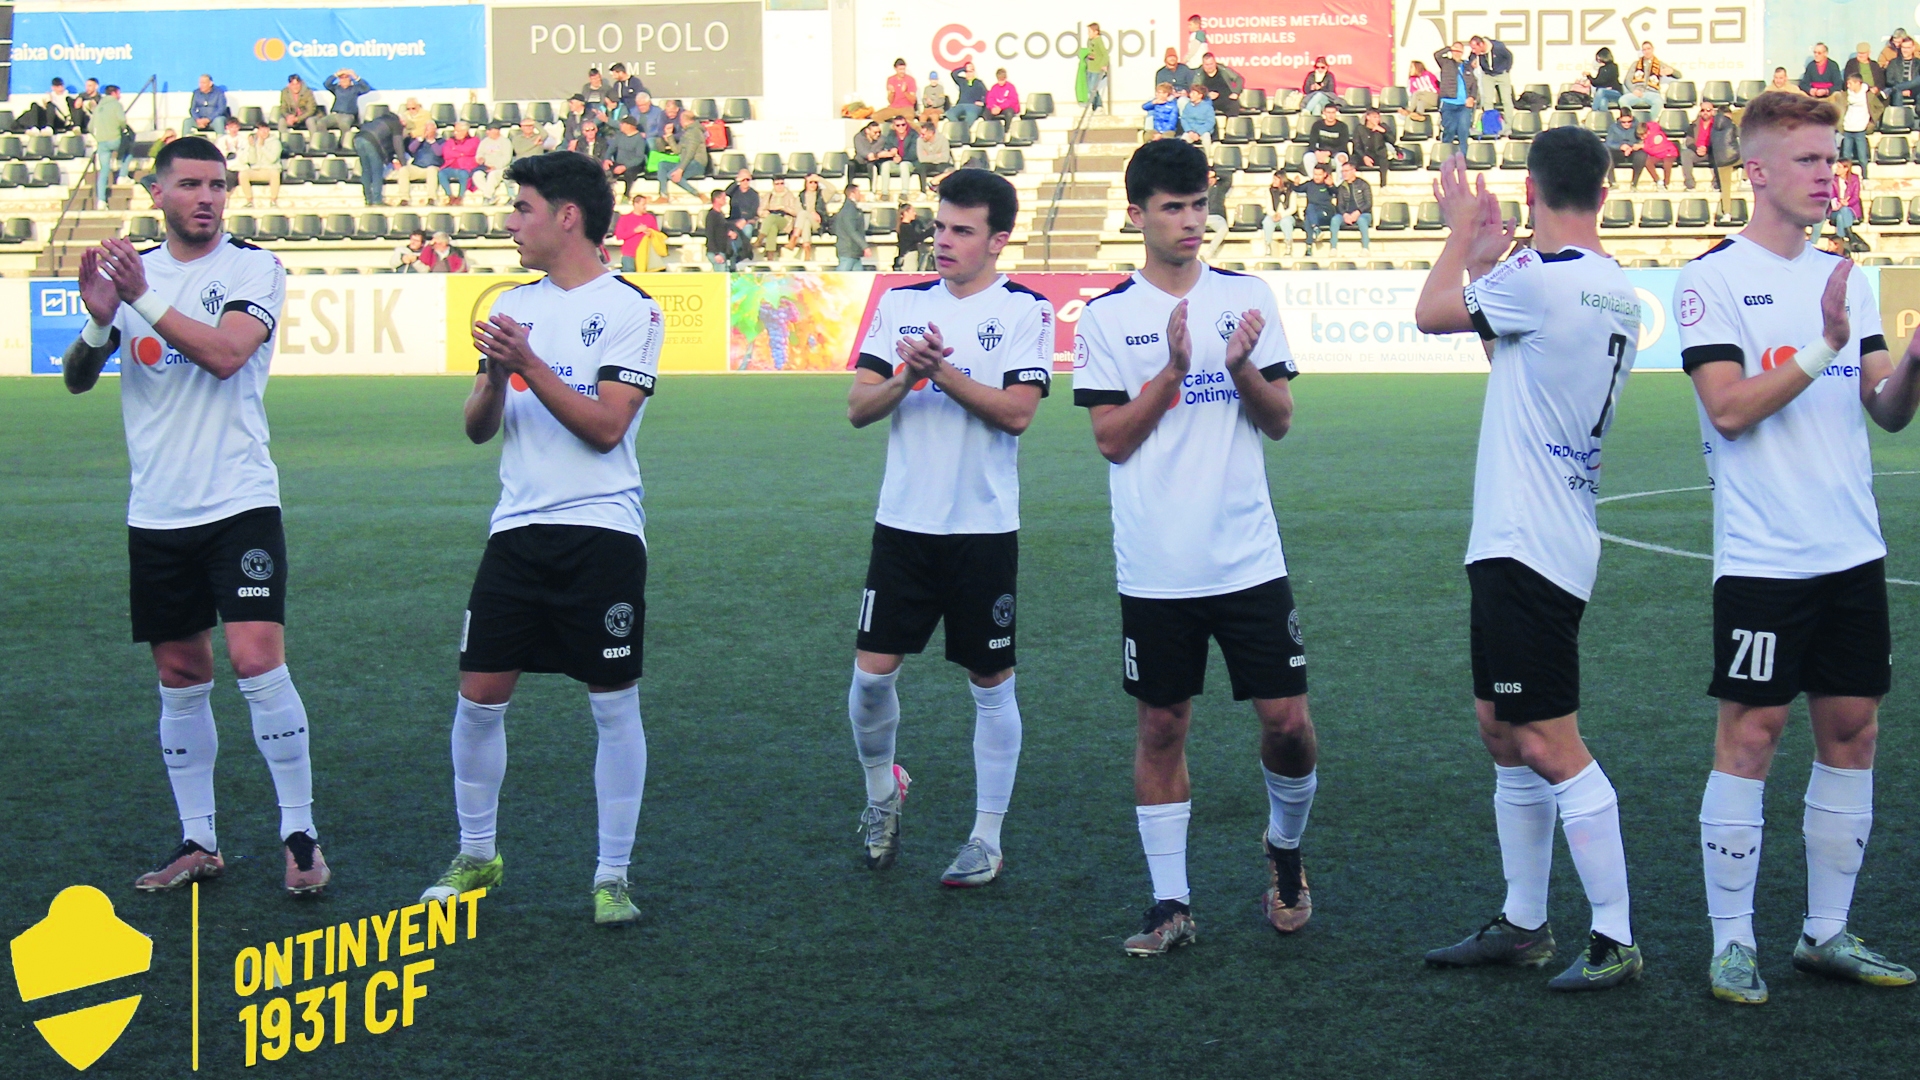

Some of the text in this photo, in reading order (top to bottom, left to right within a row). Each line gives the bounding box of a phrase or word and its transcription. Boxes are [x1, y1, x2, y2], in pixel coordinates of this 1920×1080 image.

[1200, 13, 1368, 29] SOLUCIONES METÁLICAS
[531, 21, 729, 54] POLO POLO
[1205, 32, 1296, 45] NDUSTRIALES
[11, 43, 133, 64] aixa Ontinyent
[288, 38, 426, 60] Caixa Ontinyent
[1215, 51, 1353, 69] ww.codopi.om
[1285, 282, 1416, 305] talleres
[1744, 294, 1774, 306] GIOS
[899, 325, 926, 335] GIOS
[1125, 332, 1159, 346] GIOS
[1380, 353, 1455, 362] MAQUINARIA
[1459, 353, 1476, 362] EN
[618, 369, 654, 389] GIOS
[1183, 369, 1225, 388] Caixa
[1590, 332, 1627, 438] 7
[1185, 387, 1240, 405] Ontinye
[238, 586, 270, 598] GIOS
[989, 636, 1011, 650] GIOS
[603, 645, 631, 659] GIOS
[1125, 637, 1140, 682] 6
[1727, 628, 1777, 683] 20
[1289, 655, 1307, 668] GIO
[1494, 682, 1522, 694] GIOS
